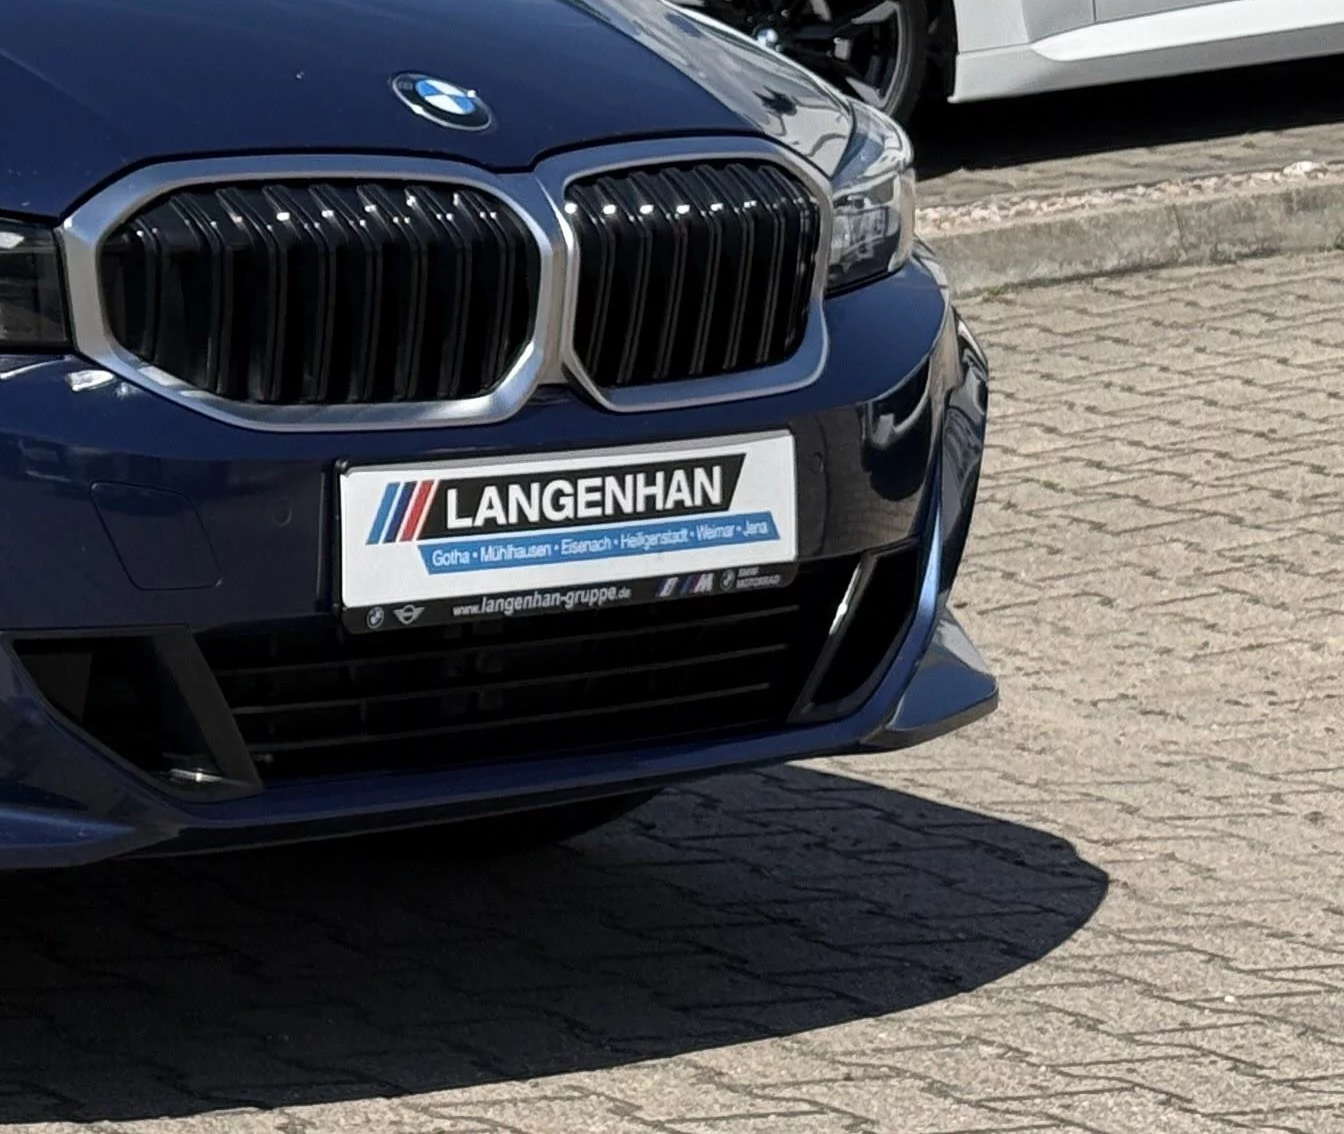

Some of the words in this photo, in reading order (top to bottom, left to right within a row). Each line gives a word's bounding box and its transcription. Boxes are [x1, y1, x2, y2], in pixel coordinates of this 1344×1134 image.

[445, 465, 723, 530] LANGENHAN
[431, 549, 470, 567] Gotha
[480, 544, 552, 563] Mühlhausen
[560, 535, 612, 555] Eisenach
[620, 526, 689, 551] Heiligenstadt
[696, 523, 735, 541] Weimar
[742, 519, 769, 537] Jena
[452, 584, 632, 616] www.langenhan-gruppe.de
